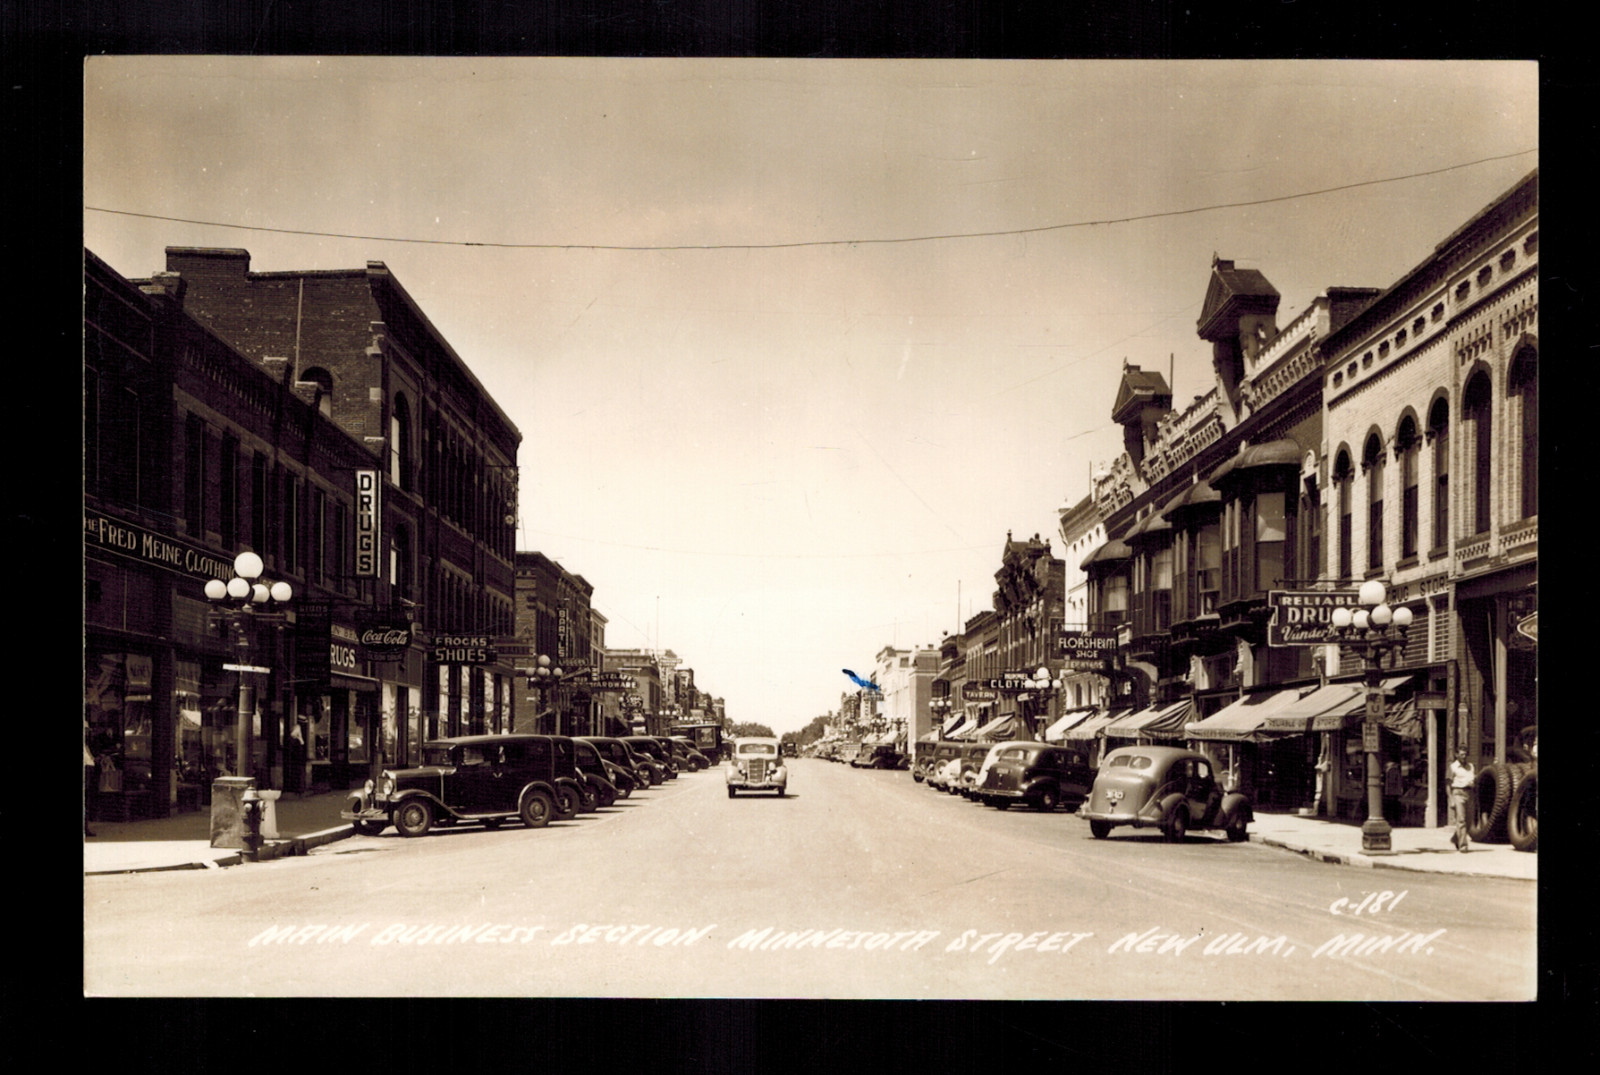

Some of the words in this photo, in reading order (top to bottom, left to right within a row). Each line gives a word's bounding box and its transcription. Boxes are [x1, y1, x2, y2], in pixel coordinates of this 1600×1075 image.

[360, 474, 372, 572] DRUGS
[85, 517, 98, 532] HE
[99, 518, 137, 550] FRED
[142, 533, 183, 565] MEINE
[1288, 607, 1362, 624] DRU
[362, 629, 409, 645] Coca-Cola
[435, 636, 487, 647] FROCKS
[1058, 637, 1116, 649] FLORSHEIM
[330, 643, 356, 668] RUGS
[435, 648, 486, 662] SHOES
[1076, 651, 1099, 659] SHOE
[991, 679, 1034, 689] CLOTH
[966, 691, 996, 699] TAVERN
